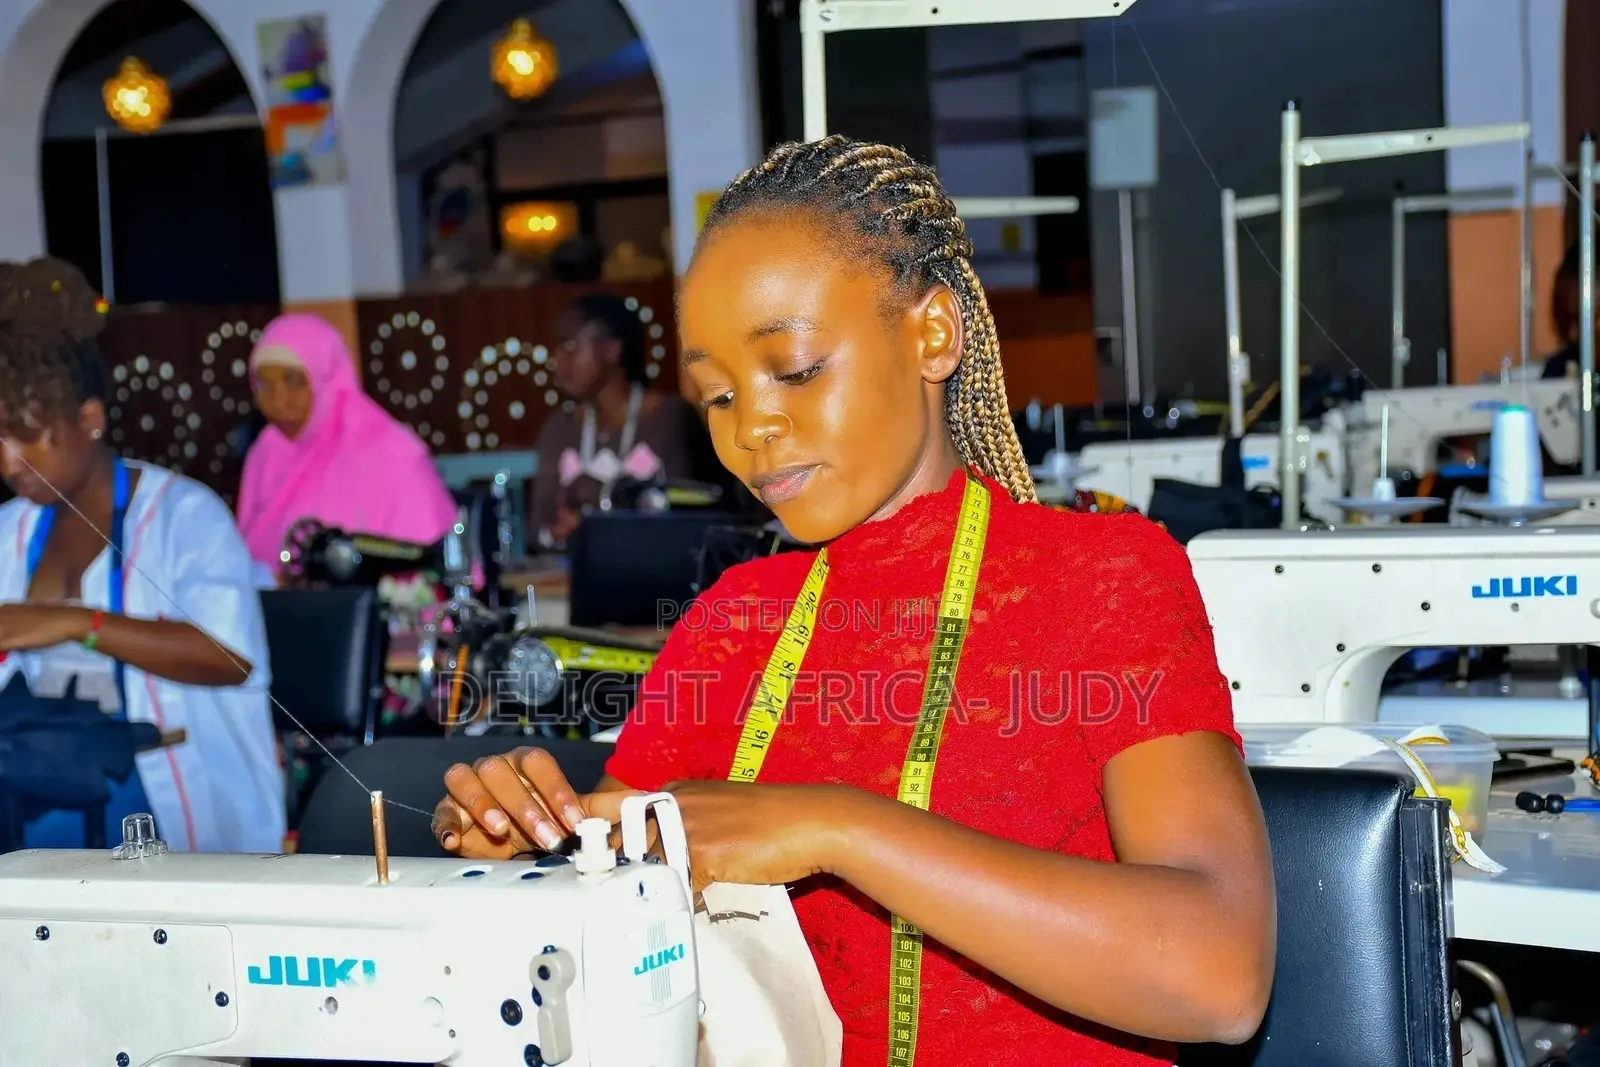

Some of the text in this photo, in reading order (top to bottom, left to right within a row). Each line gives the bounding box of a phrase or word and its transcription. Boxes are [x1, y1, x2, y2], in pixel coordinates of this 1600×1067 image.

[973, 498, 981, 508] 72
[971, 510, 979, 520] 73
[968, 523, 977, 533] 74
[964, 537, 974, 546] 75
[961, 550, 971, 560] 76
[958, 564, 968, 574] 77
[955, 579, 965, 587] 78
[1471, 575, 1577, 598] JUKI
[952, 593, 962, 602] 79
[949, 608, 959, 617] 80
[946, 623, 956, 632] 81
[943, 637, 954, 646] 82
[940, 651, 951, 660] 83
[750, 729, 769, 751] 16
[765, 693, 782, 716] 17
[779, 660, 796, 682] 18
[793, 624, 810, 648] 19
[805, 591, 817, 614] 20
[937, 665, 947, 674] 84
[927, 709, 937, 718] 87
[920, 738, 930, 747] 89
[916, 753, 927, 761] 90
[912, 767, 922, 776] 91
[909, 783, 919, 792] 92
[900, 923, 914, 933] 100
[900, 940, 913, 951] 101
[634, 943, 684, 976] JUKI
[899, 958, 912, 969] 102
[898, 976, 911, 986] 103
[898, 993, 911, 1004] 104
[897, 1011, 910, 1022] 105
[896, 1029, 909, 1040] 106
[895, 1046, 907, 1058] 107
